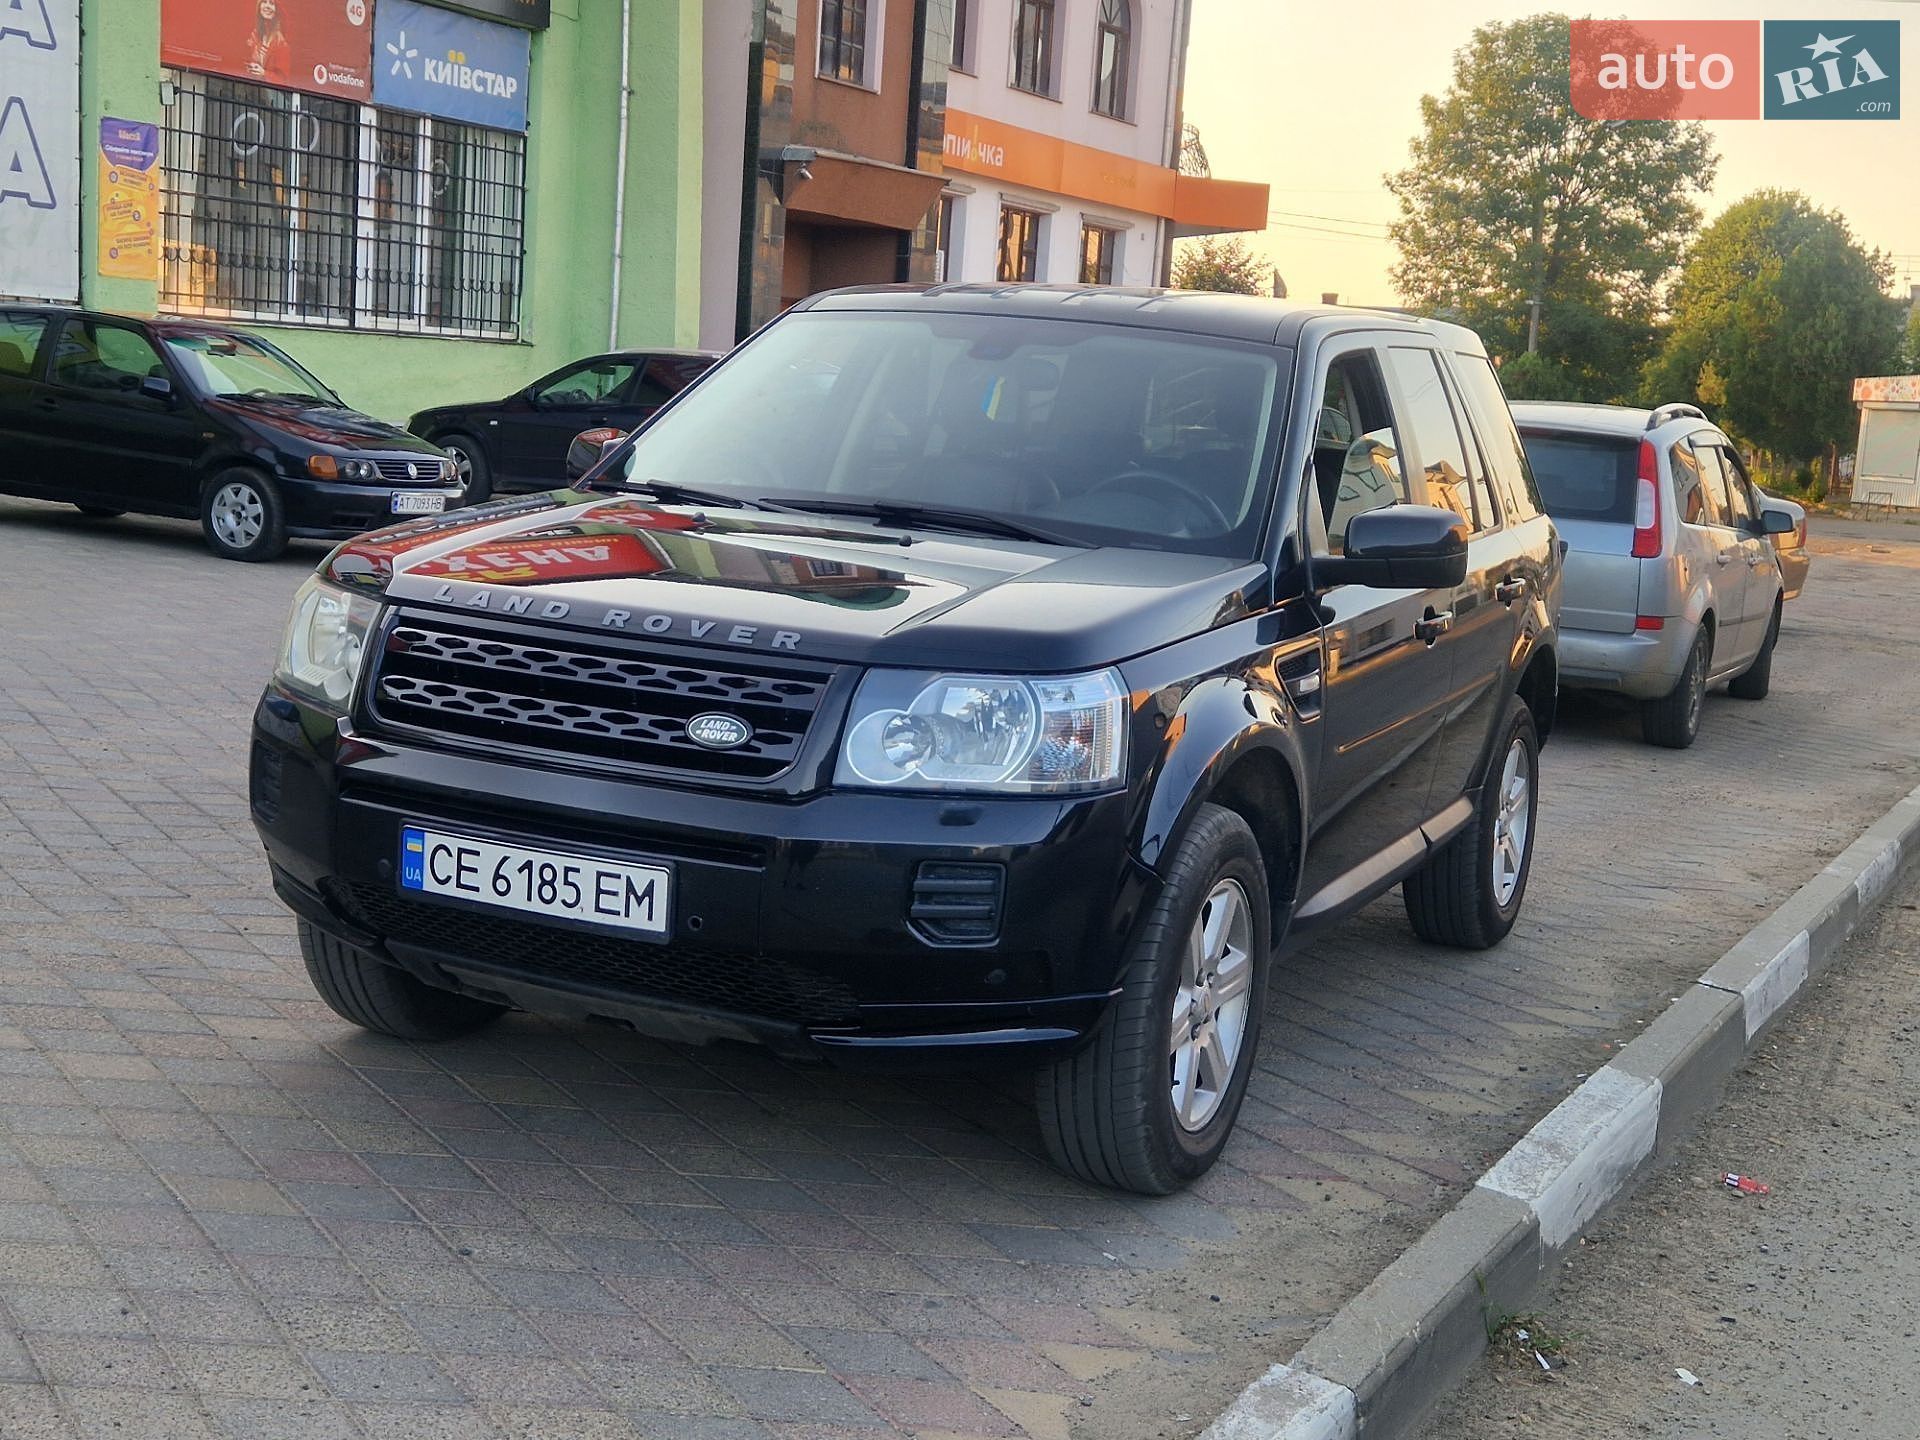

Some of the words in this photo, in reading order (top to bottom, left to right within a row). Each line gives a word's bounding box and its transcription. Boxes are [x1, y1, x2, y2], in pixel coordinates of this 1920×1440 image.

[349, 5, 362, 17] 4G
[328, 72, 364, 87] vodafone
[424, 50, 518, 99] КИЇВСТАР
[399, 497, 410, 509] AT
[433, 584, 571, 619] LAND
[602, 609, 801, 651] ROVER
[701, 719, 731, 731] LAND
[701, 729, 738, 741] ROVER
[405, 866, 422, 882] UA
[429, 843, 481, 893] CE
[491, 855, 582, 909] 6185
[594, 870, 655, 922] EM
